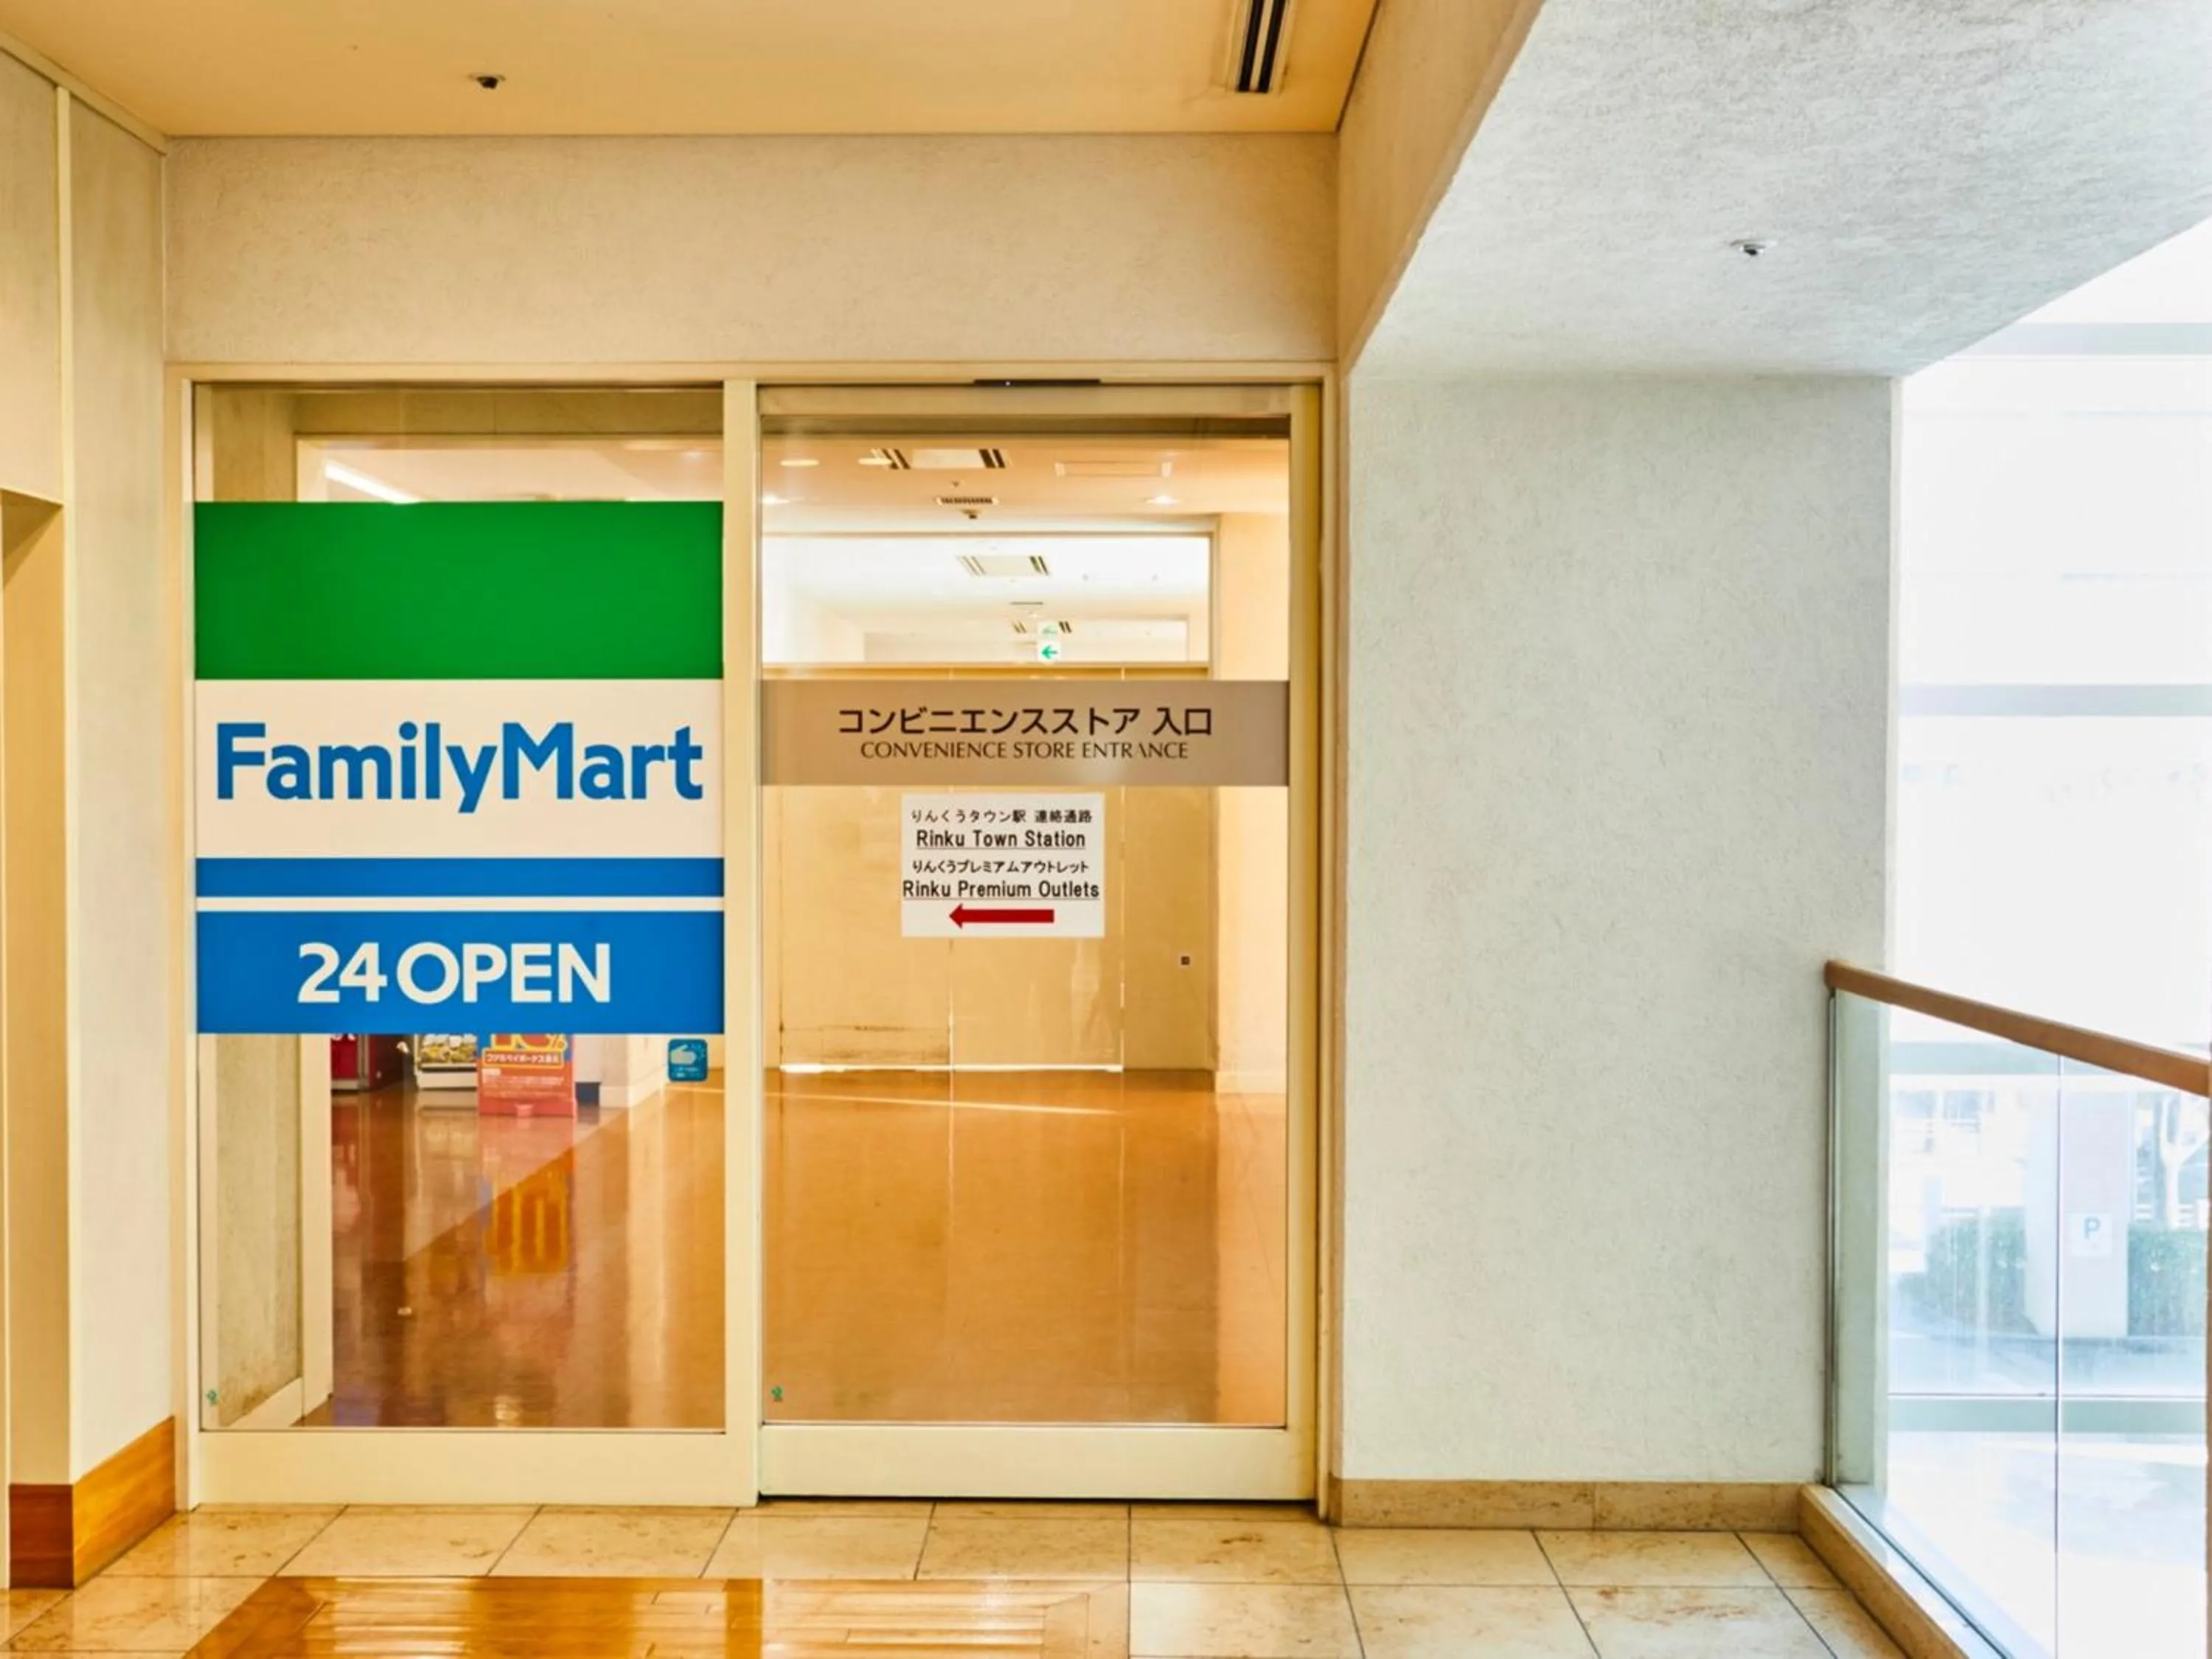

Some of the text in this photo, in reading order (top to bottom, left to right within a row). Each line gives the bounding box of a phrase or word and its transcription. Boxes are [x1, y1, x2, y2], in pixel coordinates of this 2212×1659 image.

[838, 706, 1213, 736] コンビニエンスストア 入口
[860, 741, 1007, 759] CONVENIENCE
[1012, 741, 1075, 759] STORE
[217, 720, 703, 814] FamilyMart
[911, 809, 1093, 824] りんくうタウン駅 連絡通路
[917, 829, 1085, 846] Rinku Town Station
[912, 859, 1089, 874] りんくうプレミアムアウトレット
[902, 880, 1099, 897] Rinku Premium Outlets
[297, 941, 611, 1004] 24 OPEN
[2084, 1217, 2101, 1239] P
